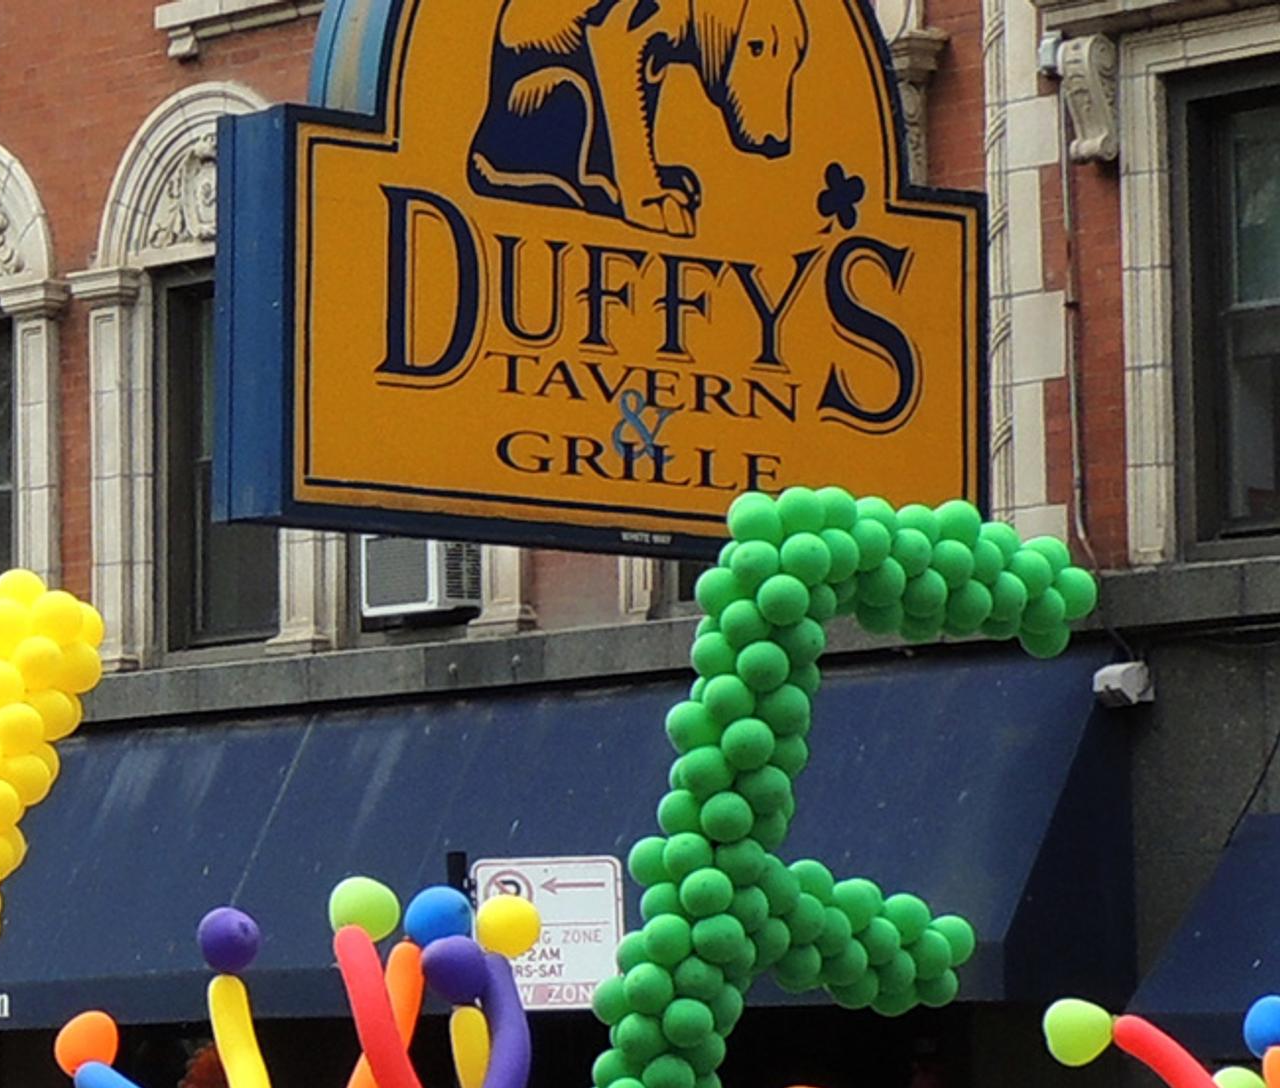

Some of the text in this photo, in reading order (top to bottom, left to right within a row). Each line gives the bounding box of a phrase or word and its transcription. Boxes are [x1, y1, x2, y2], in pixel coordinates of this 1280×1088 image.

[484, 351, 803, 422] TAVERN
[611, 388, 678, 466] &
[496, 429, 786, 495] GRILLE
[562, 929, 603, 944] ZONE
